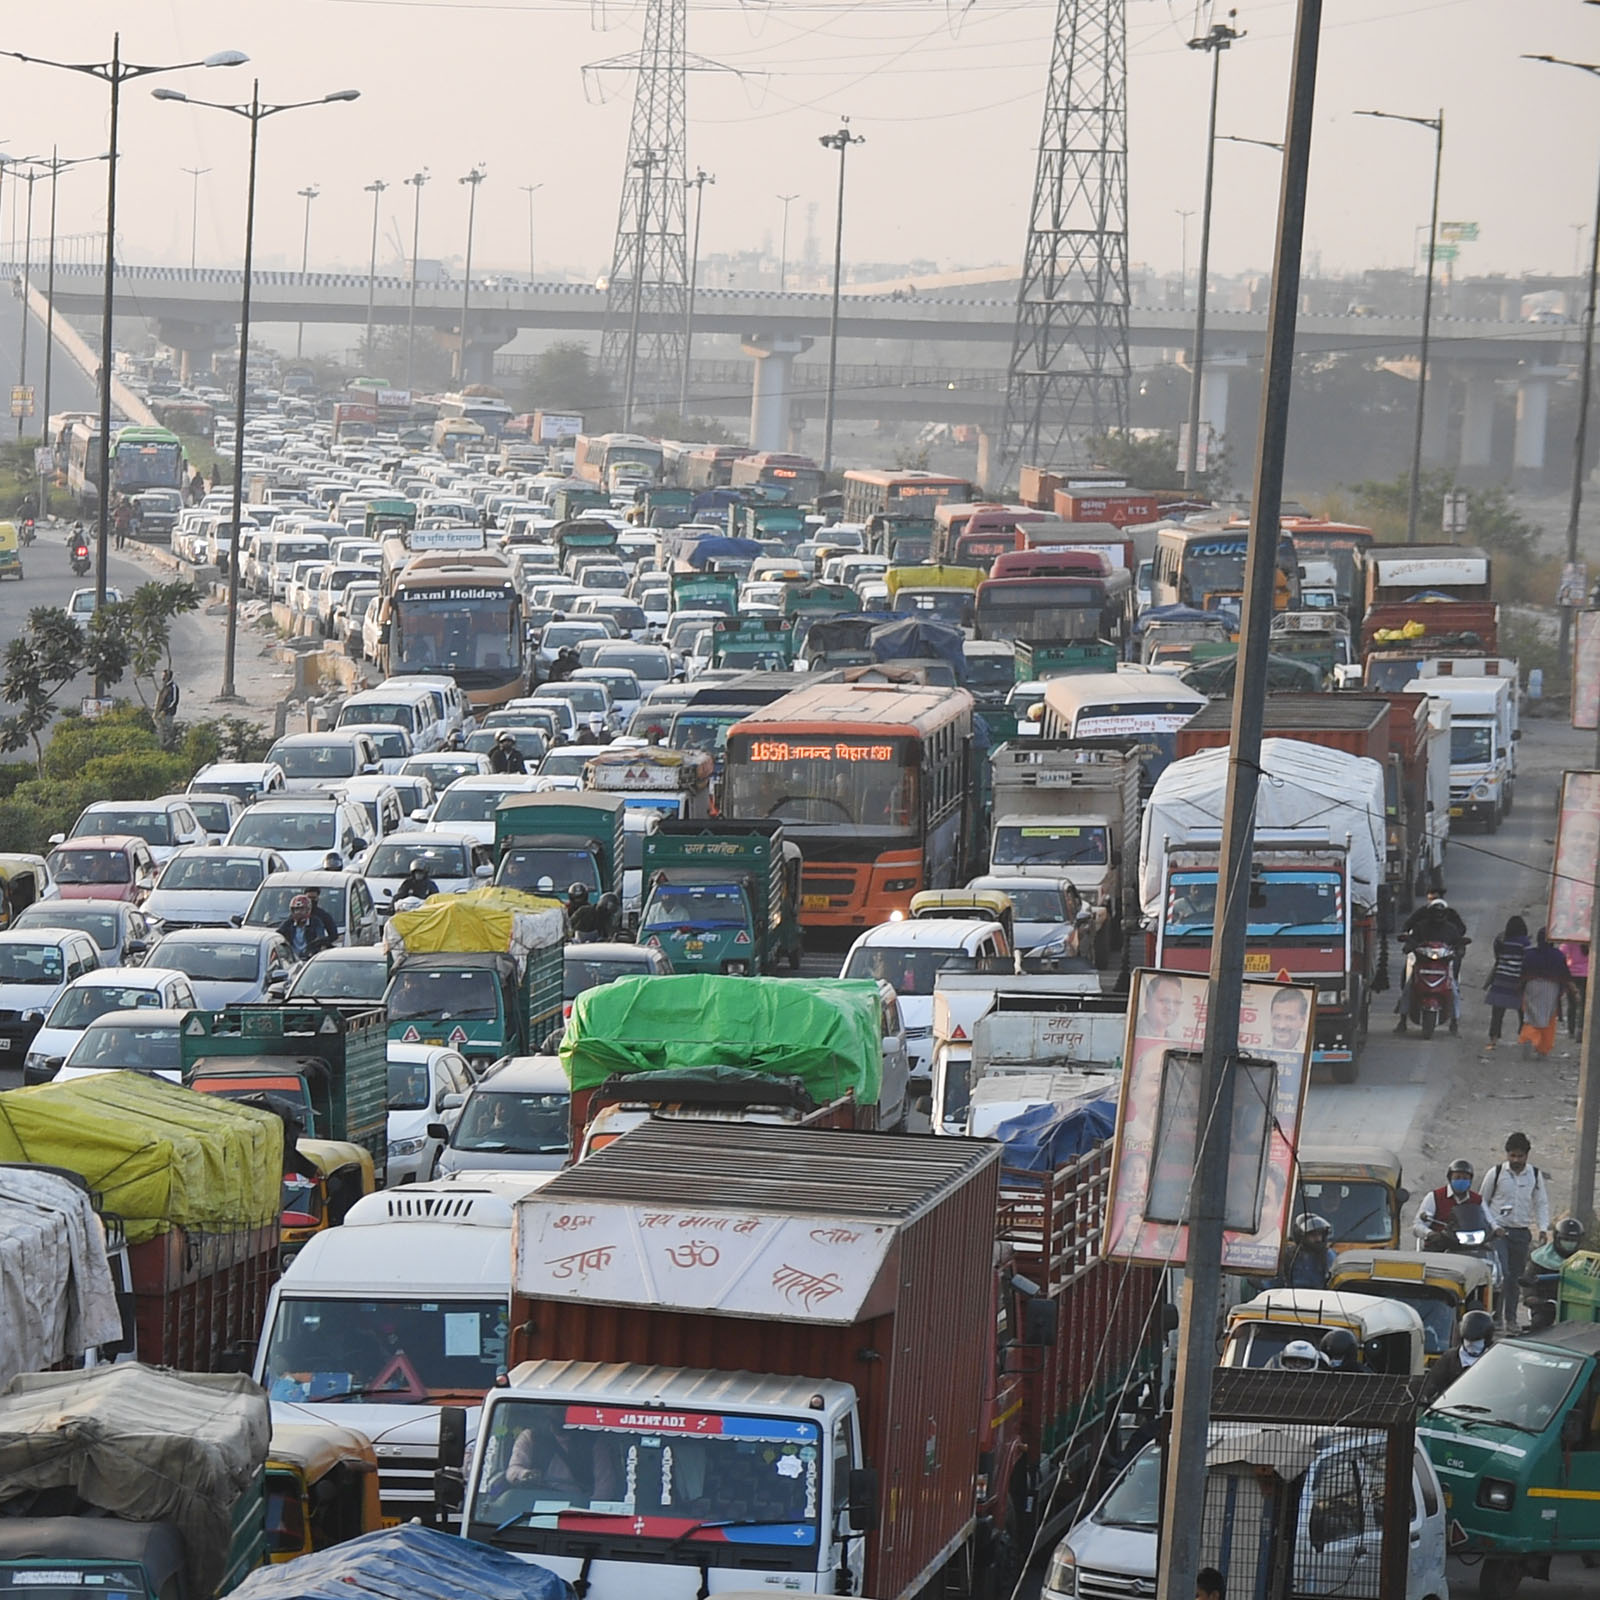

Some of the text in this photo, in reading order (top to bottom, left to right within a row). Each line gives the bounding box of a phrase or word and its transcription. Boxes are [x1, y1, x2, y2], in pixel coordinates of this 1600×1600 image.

[403, 589, 505, 601] Laxmi Holidays
[789, 745, 833, 761] आनन्द
[835, 744, 869, 762] विहार
[638, 1213, 670, 1230] जय
[679, 1213, 729, 1230] माता
[544, 1246, 617, 1279] डाक
[1447, 1458, 1465, 1469] CNG
